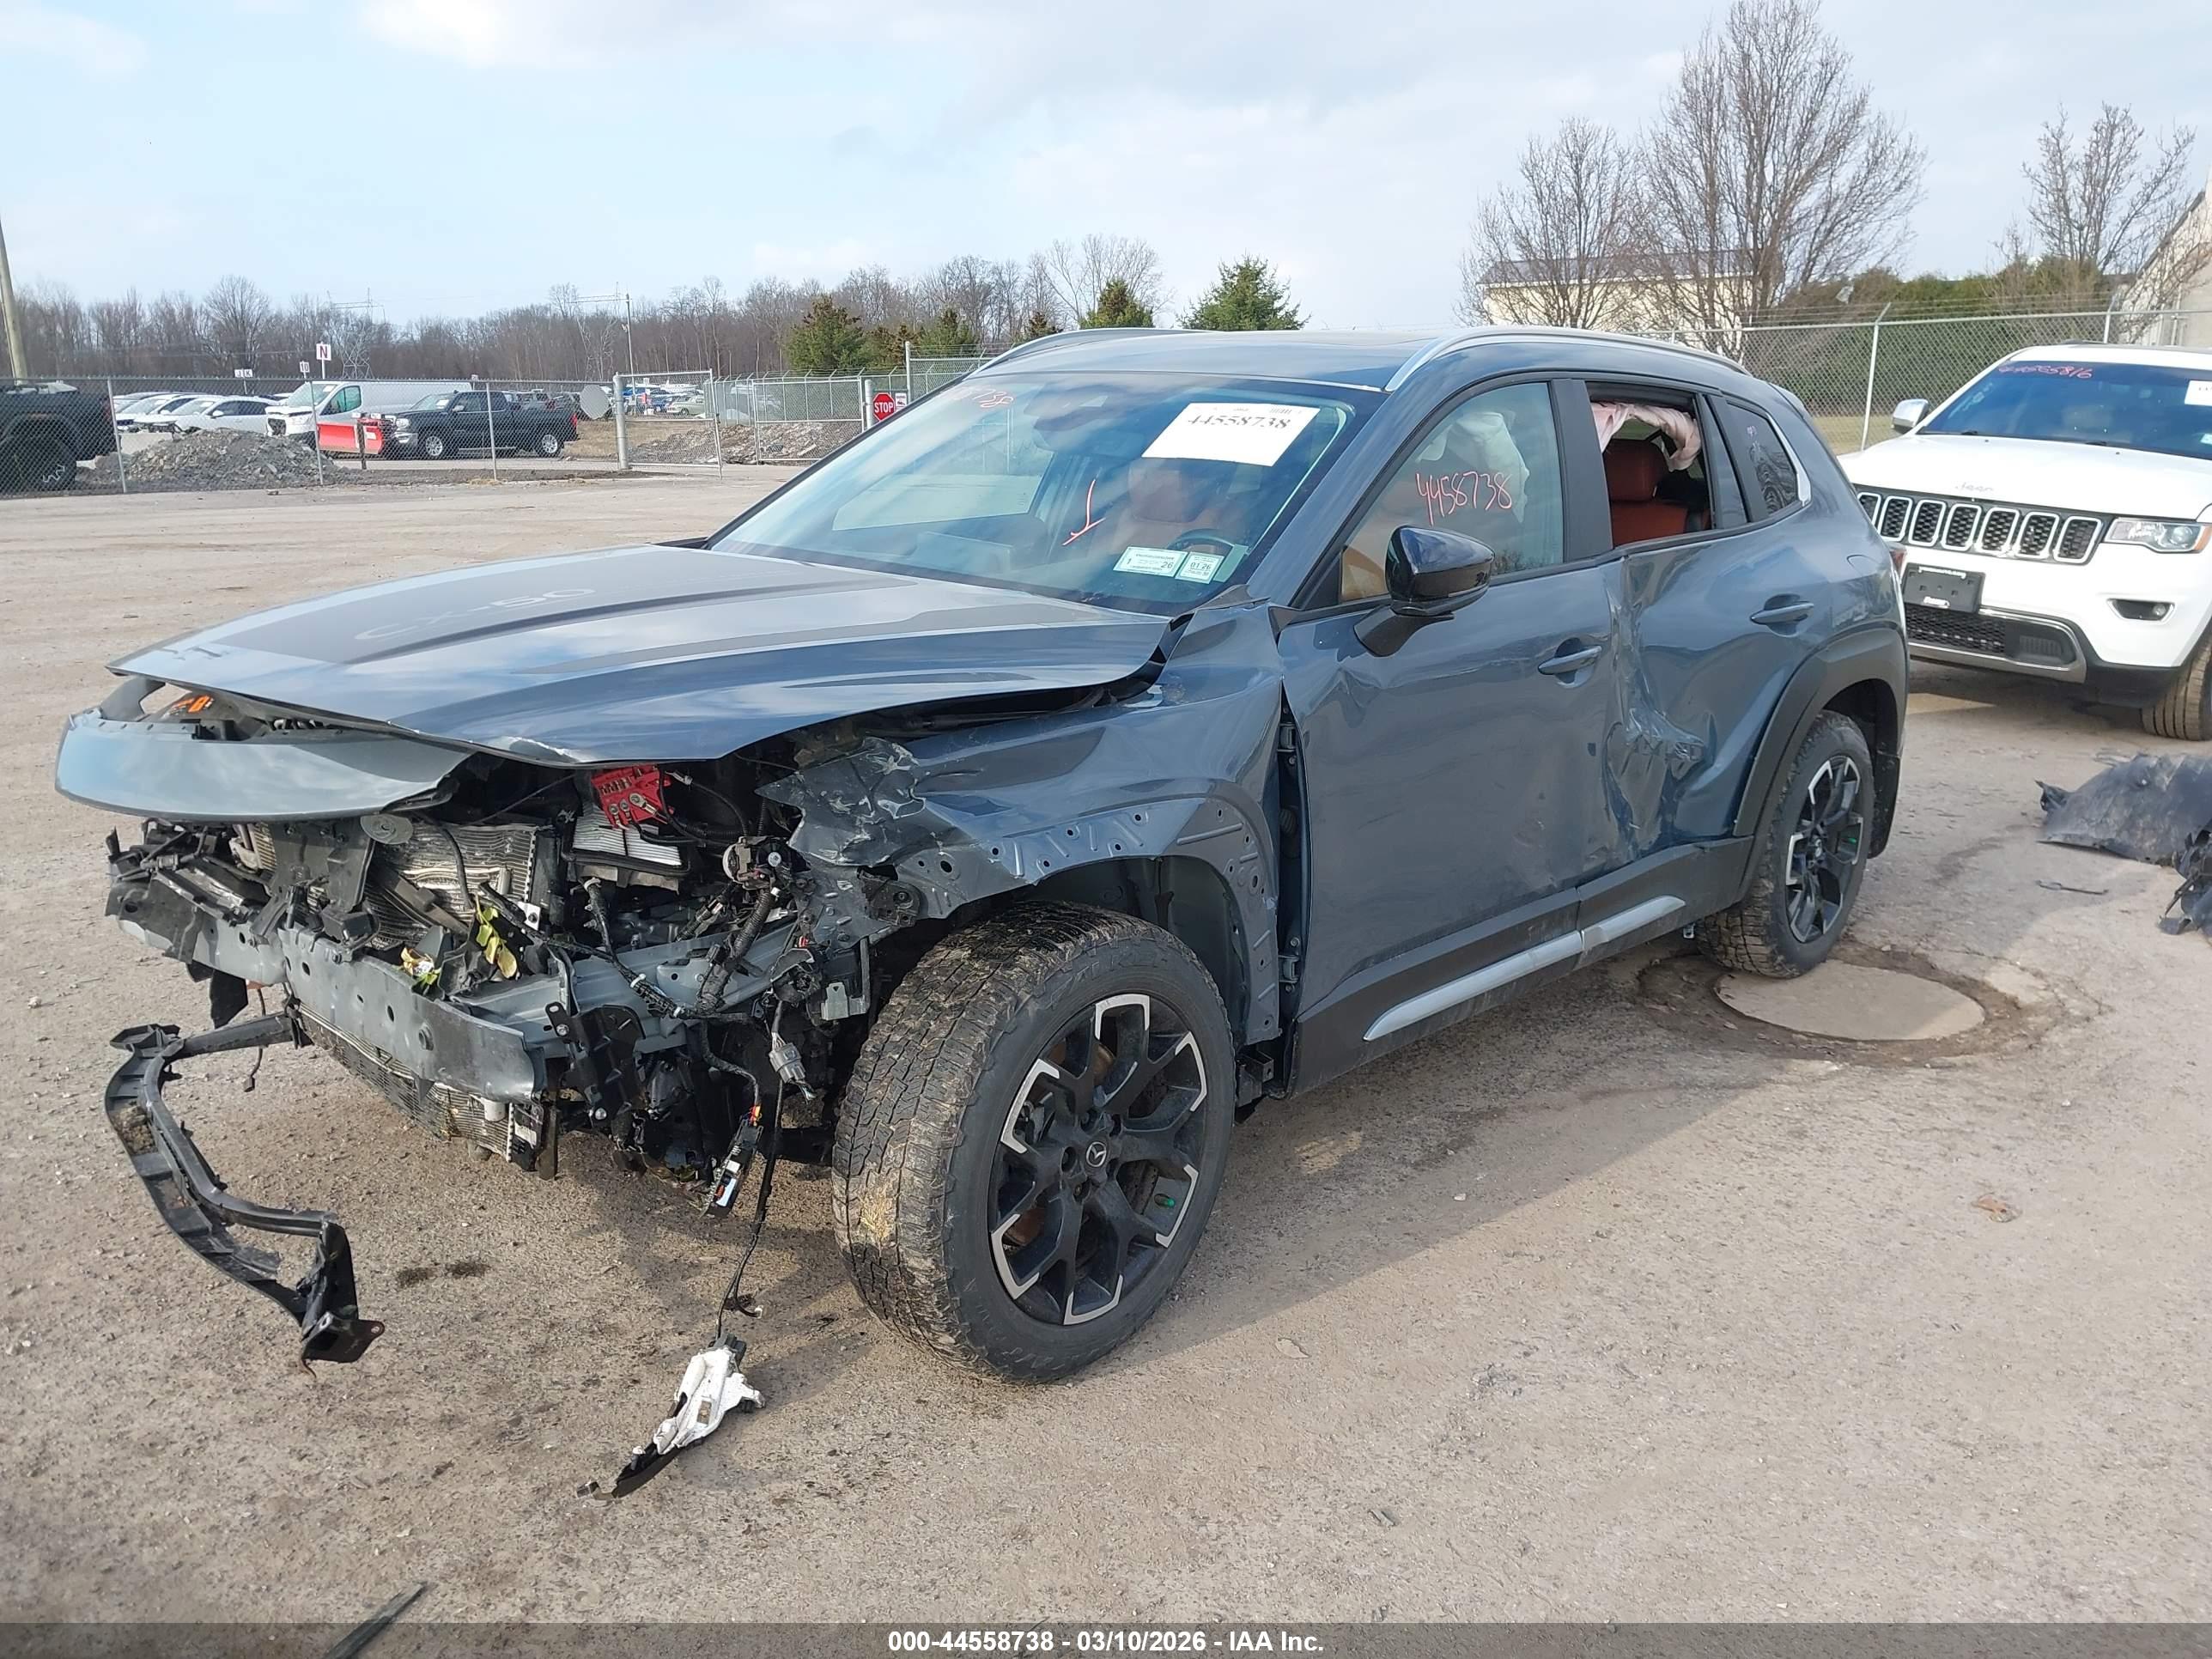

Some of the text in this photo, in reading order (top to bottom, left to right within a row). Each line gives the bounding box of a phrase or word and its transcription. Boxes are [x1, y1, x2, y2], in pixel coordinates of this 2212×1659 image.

[319, 345, 328, 359] N
[301, 363, 309, 372] 10
[874, 401, 894, 413] STOP
[1188, 414, 1291, 429] 44558738
[1416, 471, 1512, 526] 4458738
